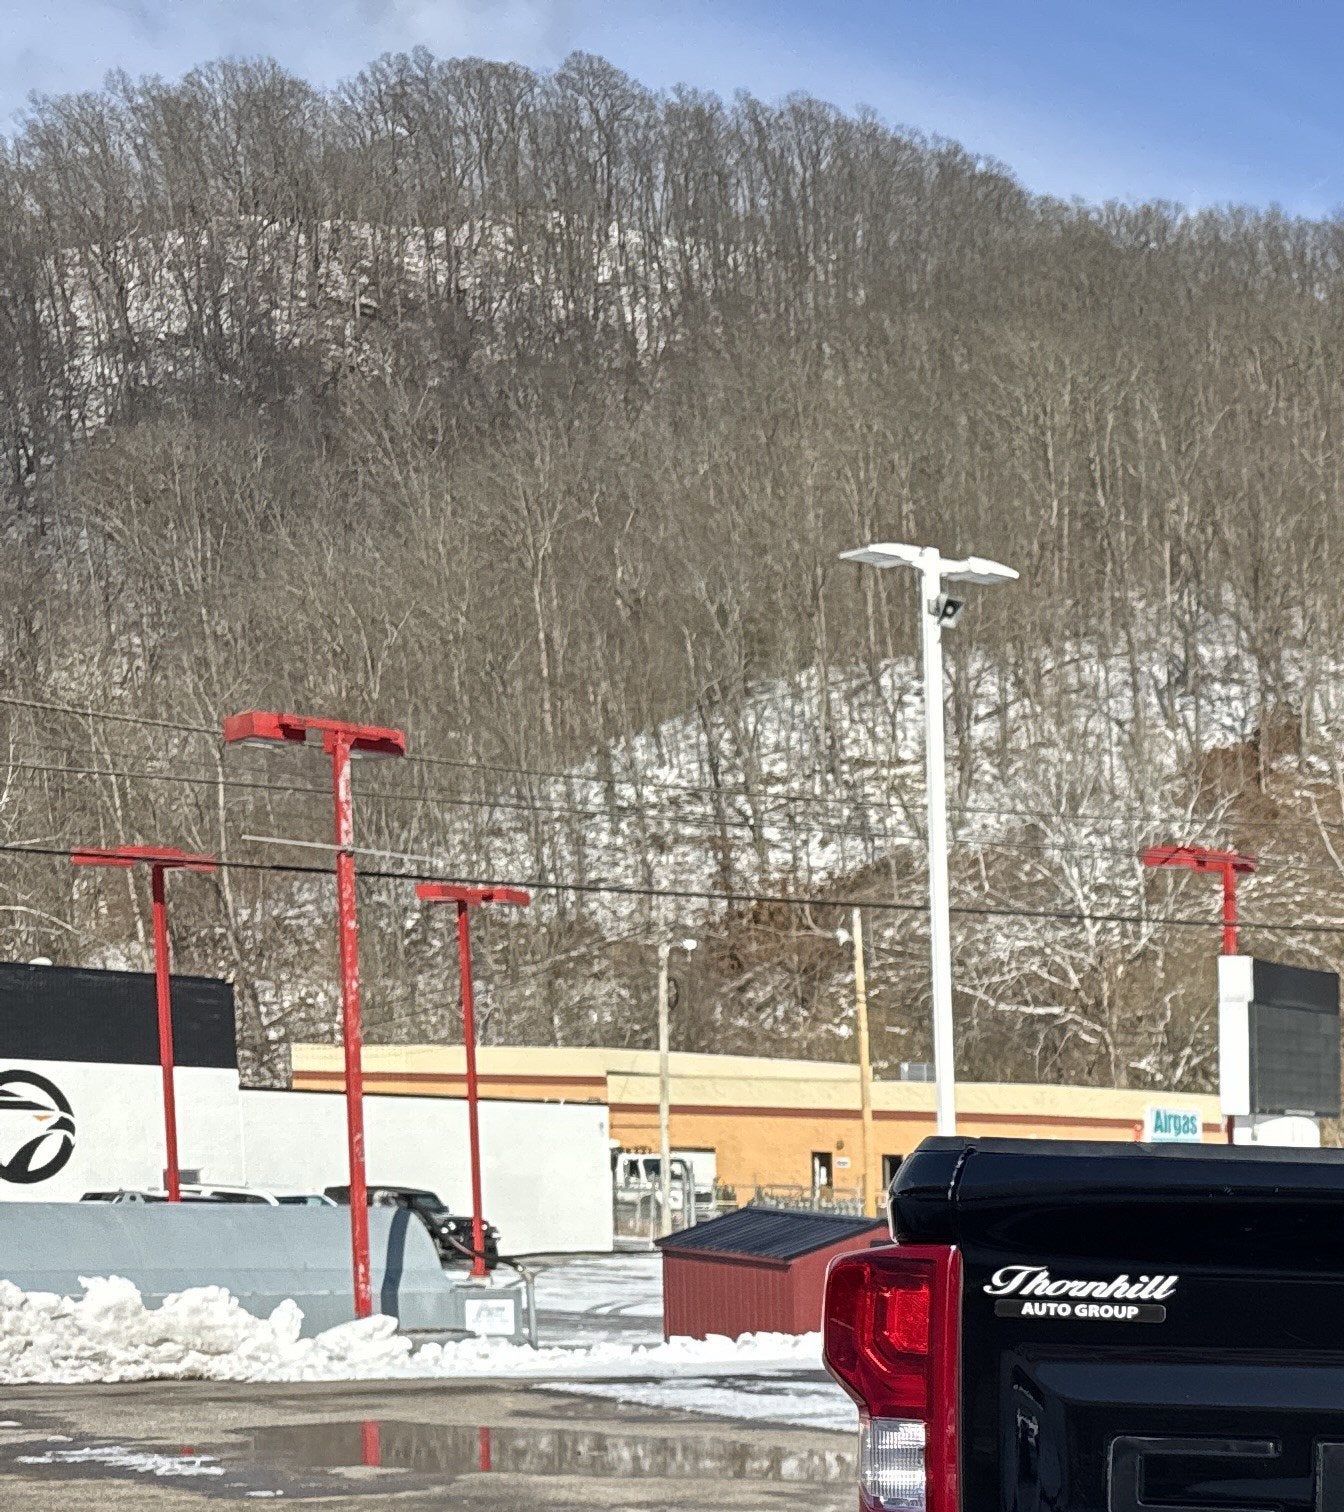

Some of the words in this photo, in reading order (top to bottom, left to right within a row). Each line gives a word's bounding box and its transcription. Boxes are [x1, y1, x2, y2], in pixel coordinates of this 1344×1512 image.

[1154, 1109, 1198, 1137] Airgas
[982, 1265, 1180, 1300] Thornhill
[1021, 1301, 1072, 1317] AUTO
[1074, 1303, 1139, 1319] GROUP
